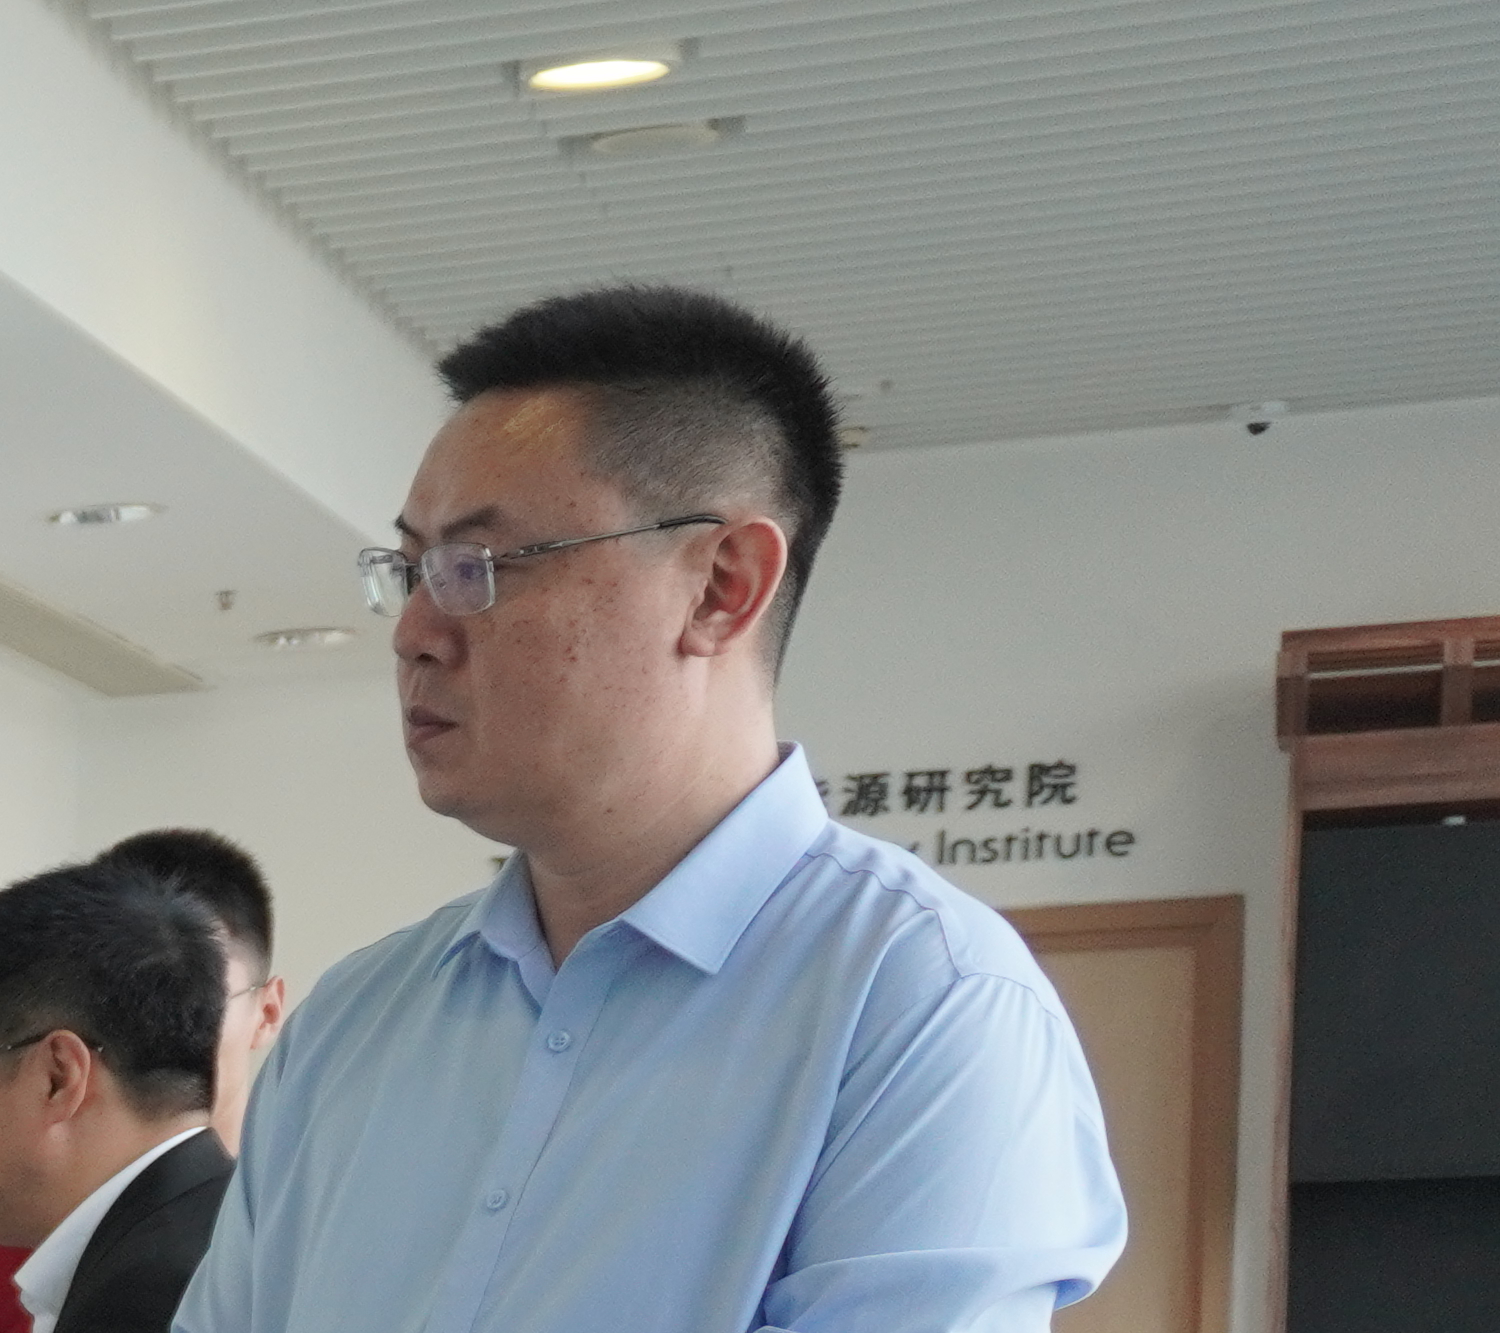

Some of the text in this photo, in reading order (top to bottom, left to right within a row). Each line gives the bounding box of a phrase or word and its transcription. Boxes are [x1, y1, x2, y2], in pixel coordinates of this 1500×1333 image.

[816, 758, 1078, 817] 源研究院
[936, 828, 1136, 866] Institute
